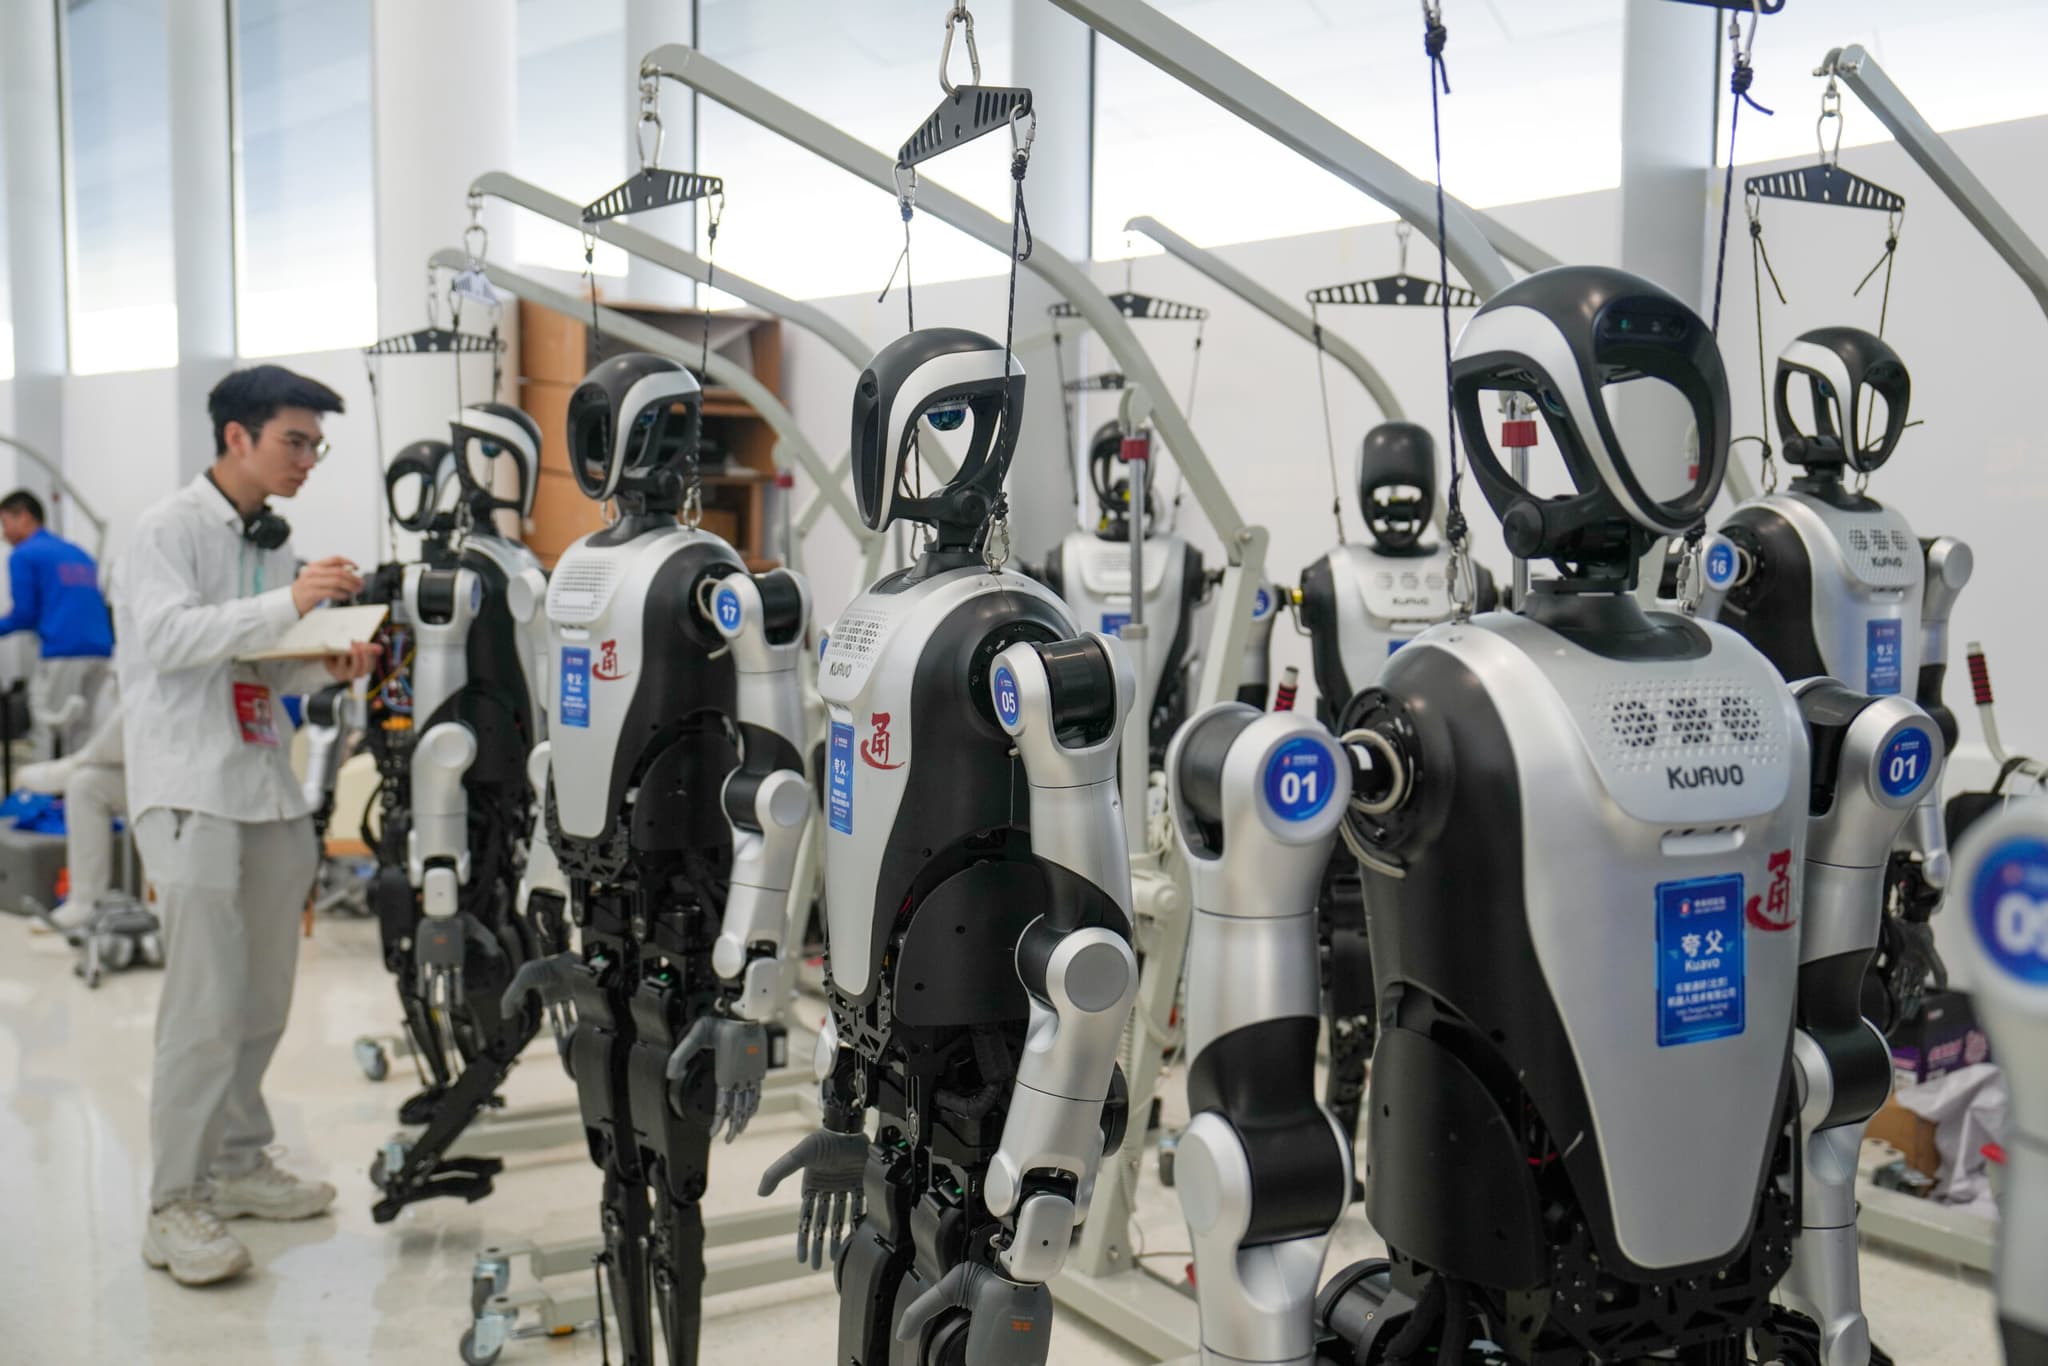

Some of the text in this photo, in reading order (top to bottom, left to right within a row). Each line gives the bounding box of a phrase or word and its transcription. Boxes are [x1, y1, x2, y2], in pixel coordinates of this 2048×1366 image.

[1711, 559, 1727, 575] 16
[722, 604, 737, 622] 17
[1001, 690, 1016, 714] 05
[1666, 763, 1744, 789] KUAVO
[1889, 754, 1917, 782] 01
[1280, 770, 1317, 804] 01
[1681, 929, 1724, 957] 夸父
[1684, 958, 1721, 972] Kuavo
